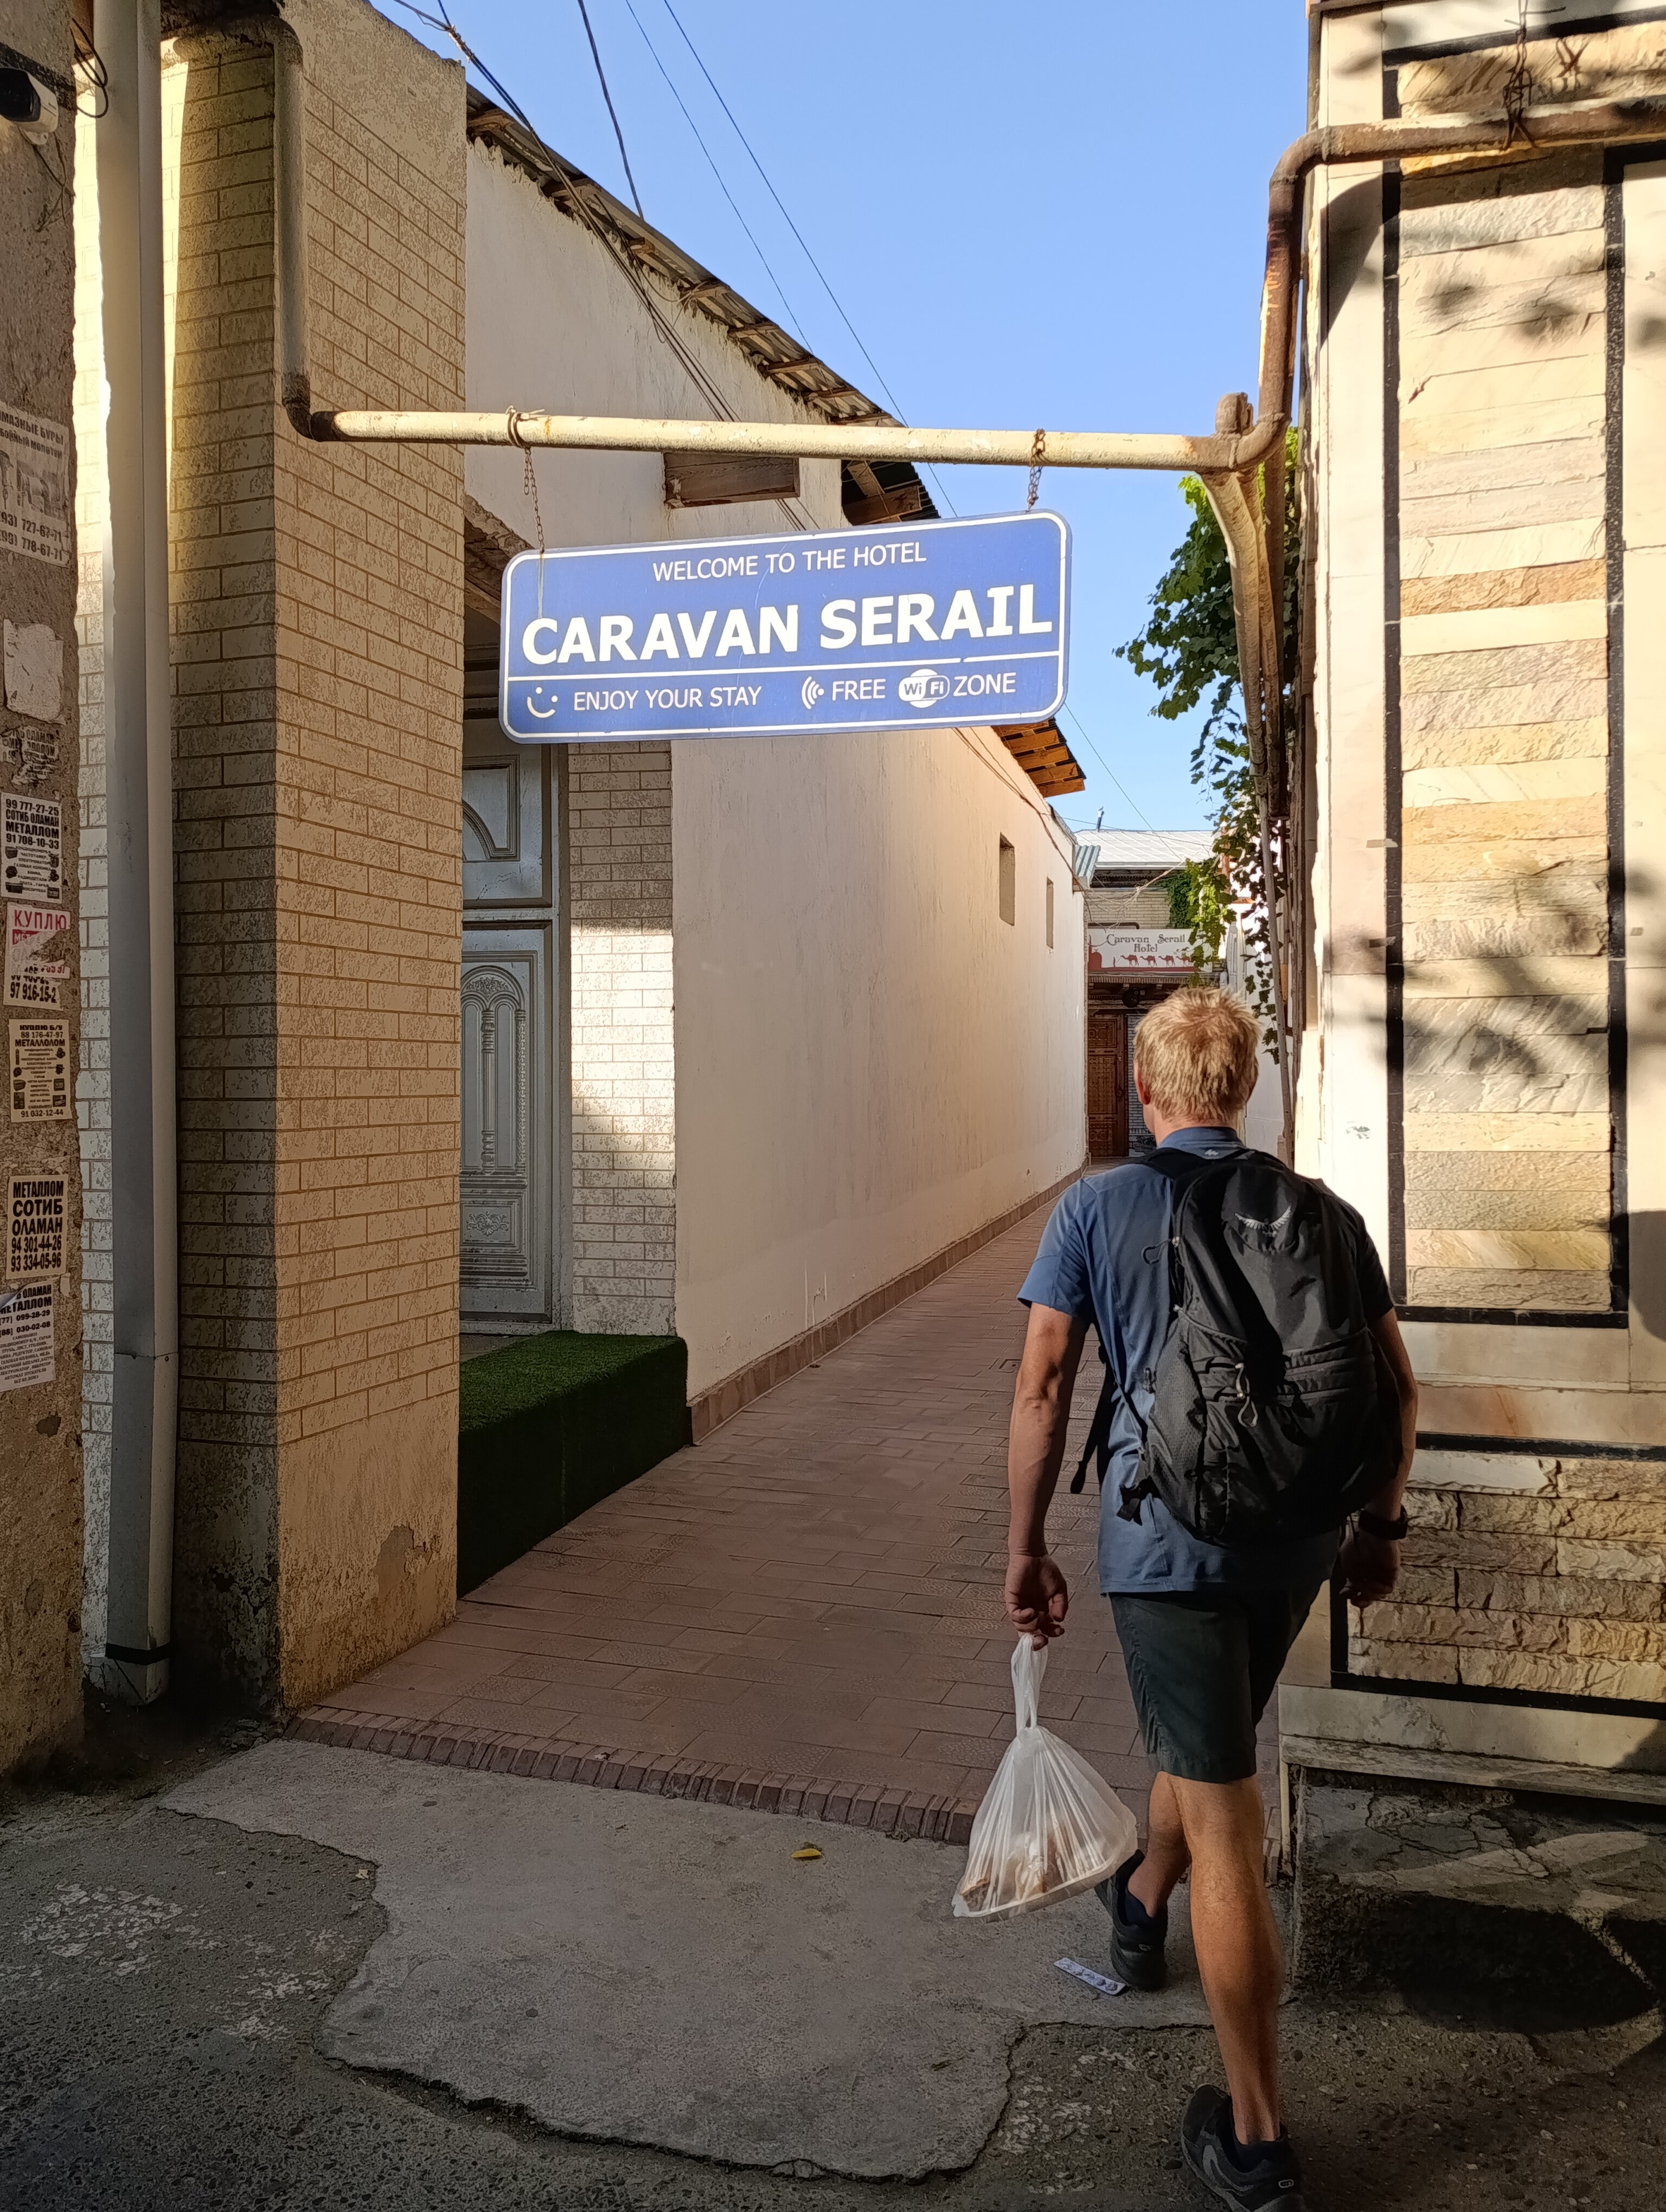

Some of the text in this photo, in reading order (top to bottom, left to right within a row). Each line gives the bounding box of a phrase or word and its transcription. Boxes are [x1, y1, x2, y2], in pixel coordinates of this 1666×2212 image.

[0, 410, 63, 446] МАЗНЫЕ БУРЫ
[22, 537, 62, 561] 778-67-71
[653, 542, 927, 581] WELCOME TO THE HOTEL
[523, 584, 1052, 665] CARAVAN SERAIL
[832, 679, 886, 701] FREE
[953, 673, 1016, 697] ZONE
[574, 686, 762, 711] ENJOY YOUR STAY
[5, 798, 59, 816] 99 777-27-25
[5, 808, 59, 827] СОТИБ ОЛАМАН
[5, 820, 59, 839] МЕТАЛЛОМ
[6, 833, 59, 850] 91 708-10-33
[14, 909, 67, 930] КУПЛЮ
[1107, 934, 1185, 946] Caravan Serail
[1133, 944, 1158, 953] Hotel
[10, 982, 20, 998] 97
[15, 1039, 65, 1047] МЕТАЛЛОЛОМ
[30, 1109, 63, 1117] 032-12-44
[13, 1180, 64, 1198] МЕТАЛЛОМ
[12, 1199, 63, 1217] СОТИБ
[12, 1217, 63, 1236] ОЛАМАН
[11, 1234, 62, 1254] 94 301-44-26
[11, 1251, 62, 1272] 93 334-05-96
[23, 1284, 52, 1298] ОЛАМАН
[16, 1309, 50, 1321] 099-28-29
[17, 1321, 50, 1333] 030-02-08
